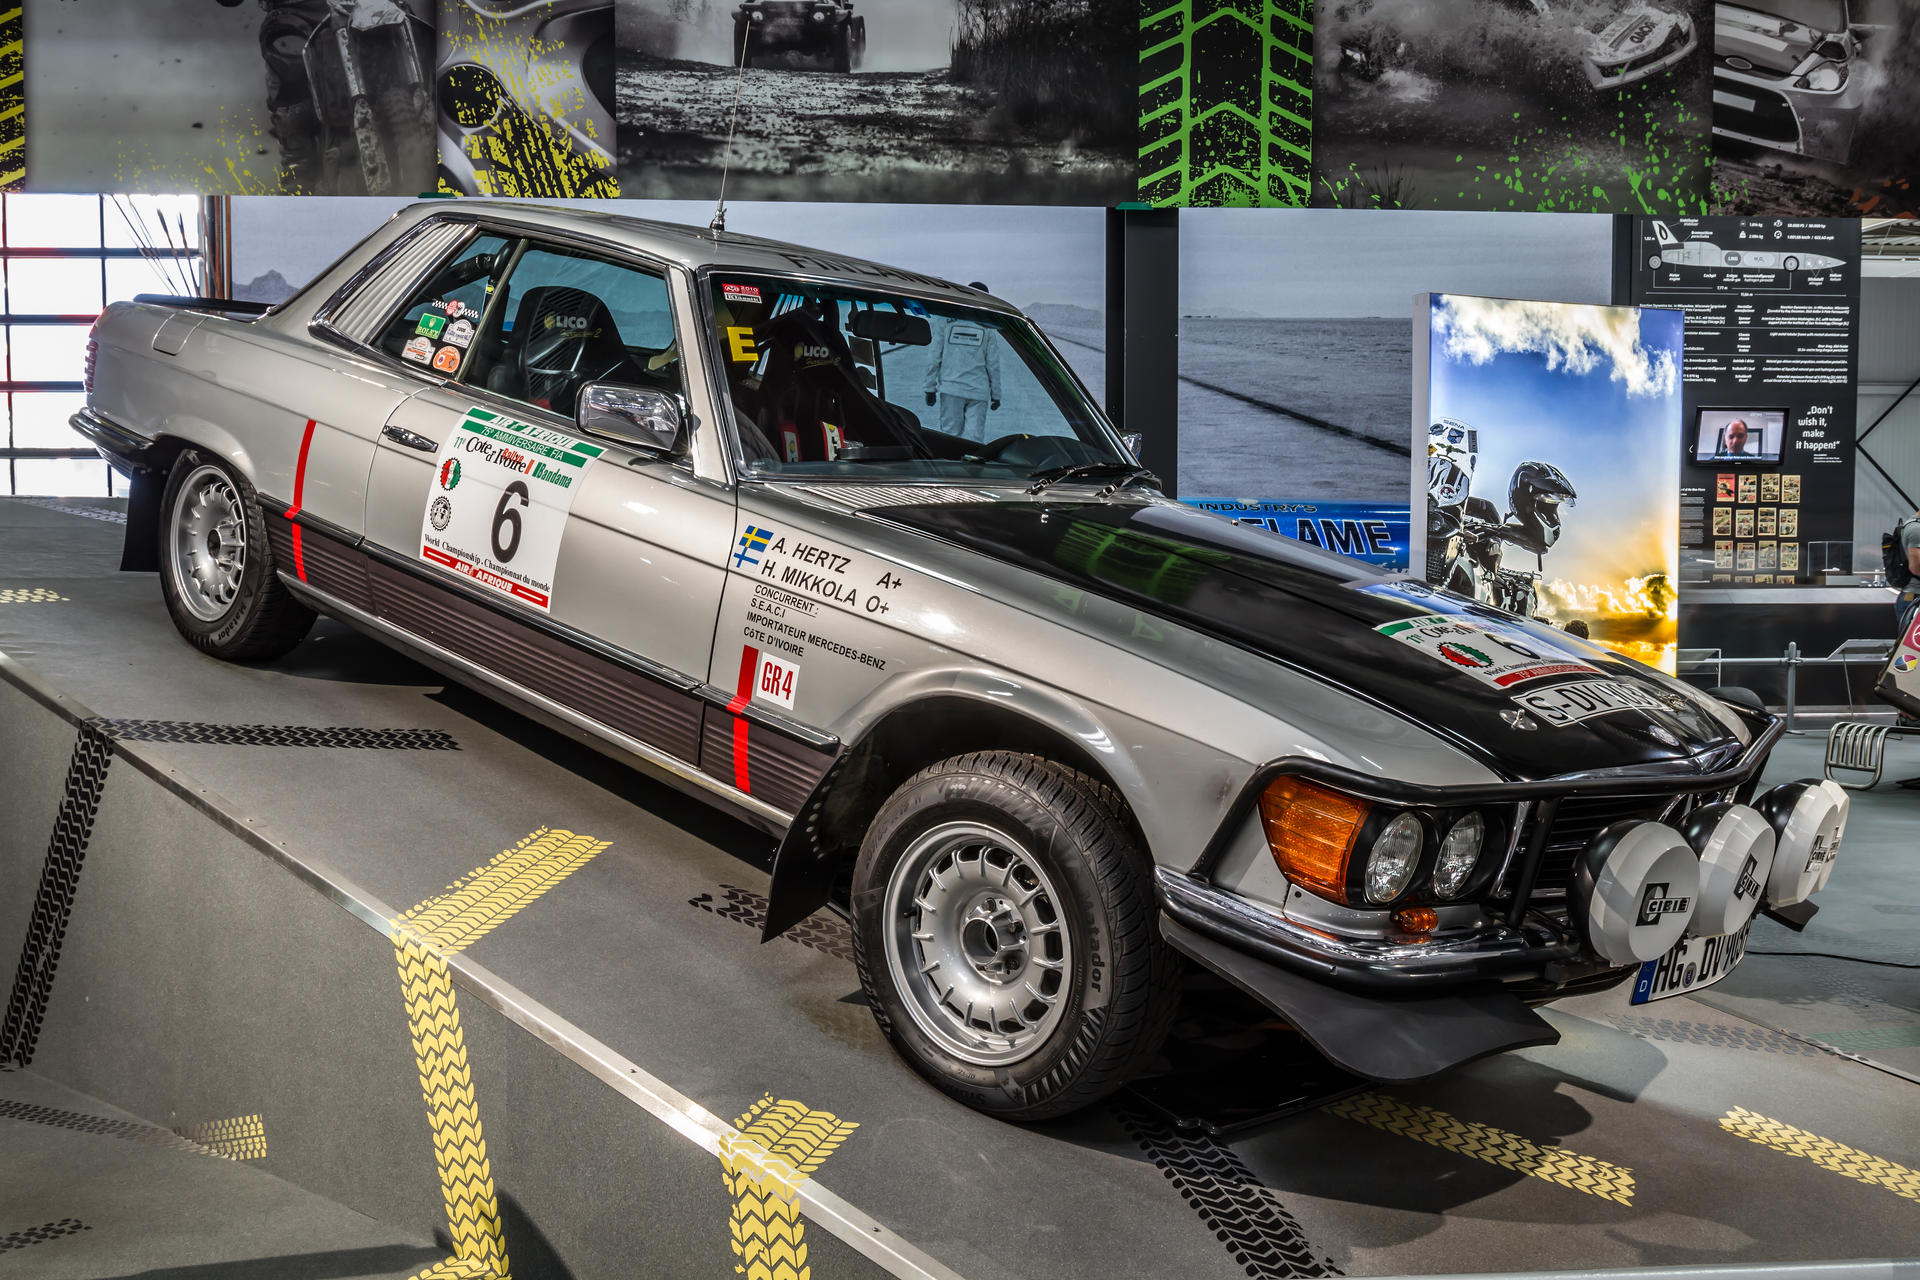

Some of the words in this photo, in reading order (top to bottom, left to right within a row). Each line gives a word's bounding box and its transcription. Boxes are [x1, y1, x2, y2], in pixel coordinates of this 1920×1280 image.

[417, 327, 440, 337] ROLEX
[556, 315, 587, 329] LICO
[726, 326, 759, 361] E
[803, 345, 829, 358] LICO
[1798, 418, 1817, 426] wish
[1819, 418, 1827, 428] it,
[1802, 429, 1825, 438] make
[550, 449, 564, 460] FIA
[1796, 441, 1802, 450] it
[538, 461, 573, 489] Bandama
[491, 480, 529, 563] 6
[424, 533, 440, 547] World
[522, 575, 531, 584] du
[530, 579, 551, 593] monde
[771, 537, 787, 555] A.
[792, 543, 851, 574] HERTZ
[877, 572, 903, 589] A+
[454, 561, 470, 575] AIR
[476, 570, 514, 593] AFRIQUE
[761, 559, 776, 579] H.
[781, 566, 857, 606] MIKKOLA
[746, 611, 807, 641] IMPORTATEUR
[807, 634, 886, 671] MERCEDES-BENZ
[767, 634, 805, 657] D'IVOIRE
[1484, 632, 1541, 660] 6
[1639, 980, 1649, 993] D
